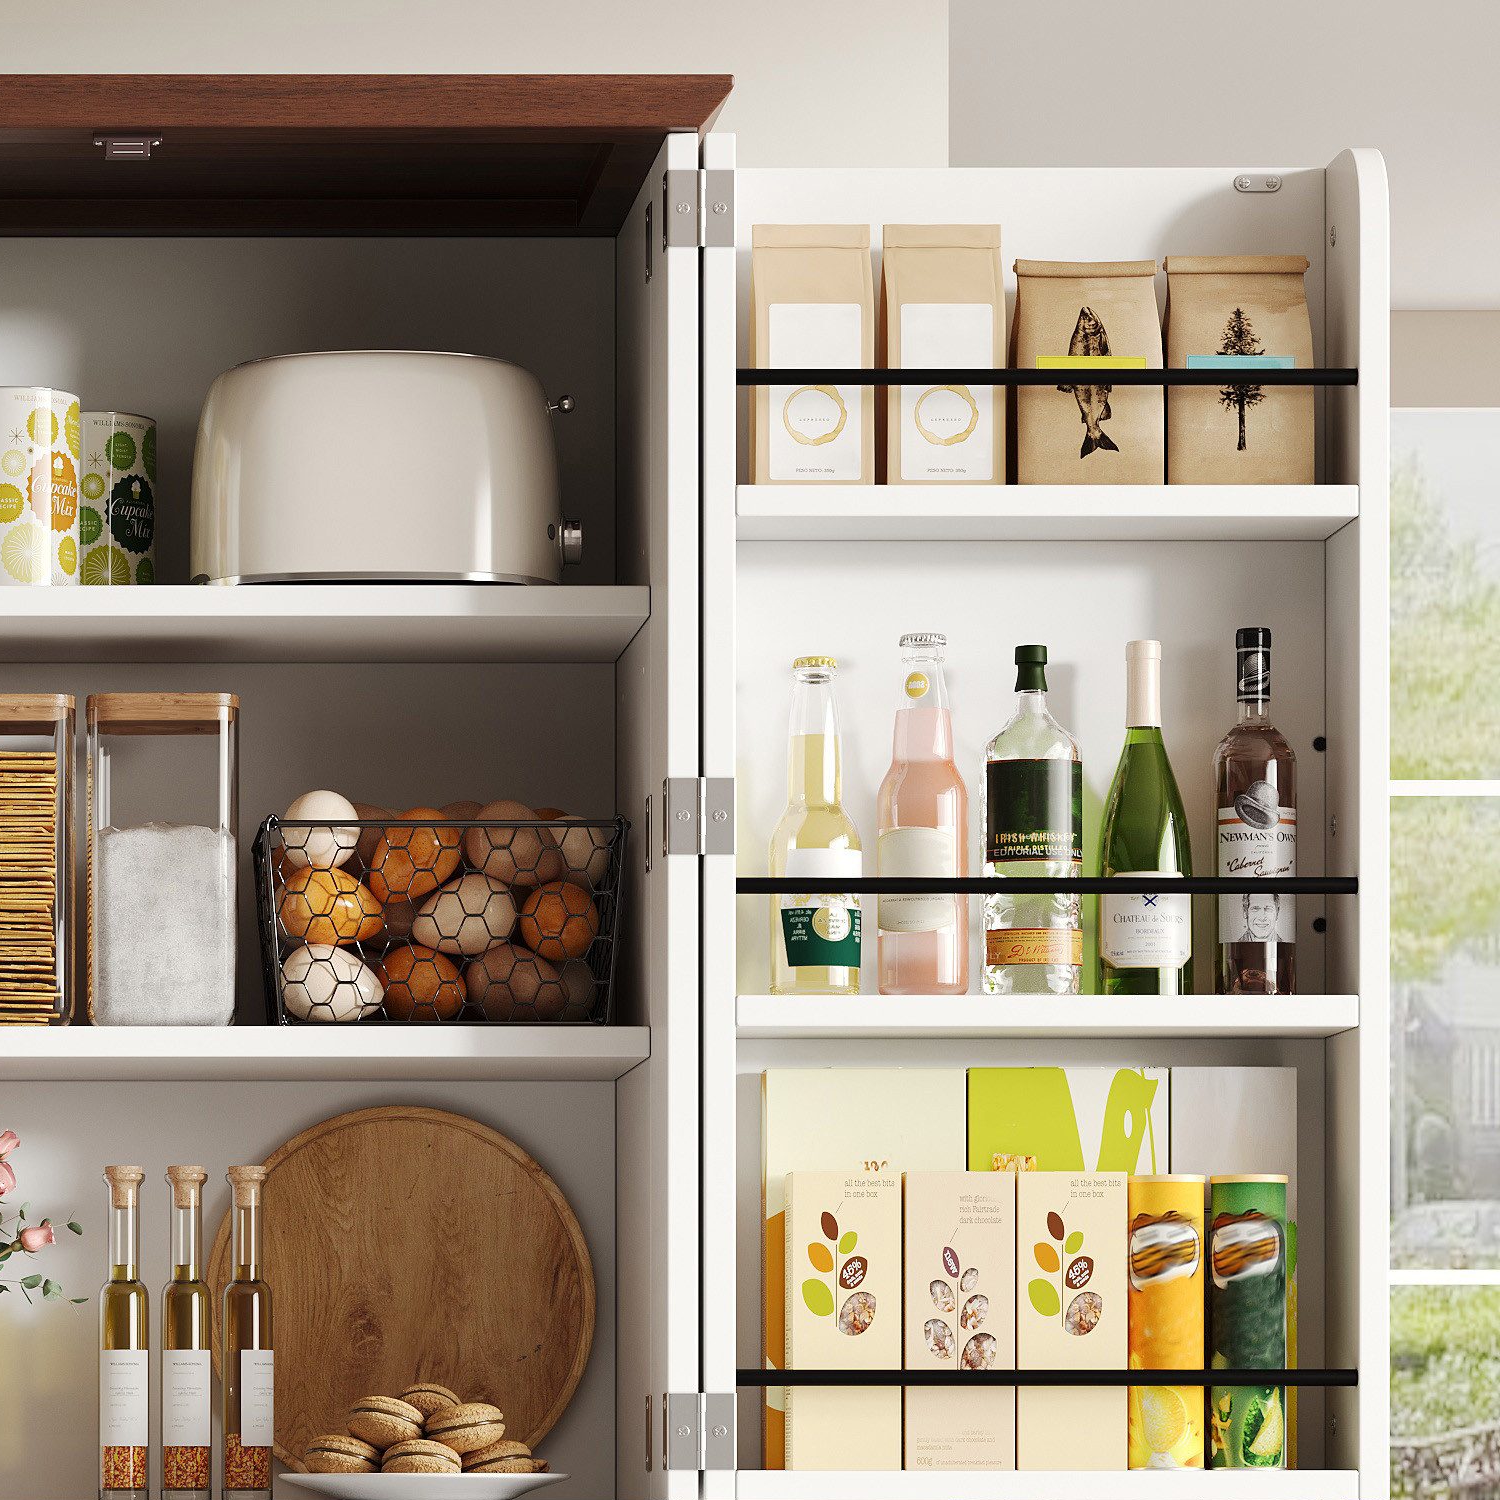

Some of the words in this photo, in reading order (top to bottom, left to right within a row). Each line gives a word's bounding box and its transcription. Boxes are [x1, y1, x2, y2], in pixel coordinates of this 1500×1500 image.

[31, 475, 77, 498] Cupcake
[50, 497, 75, 517] Mix
[110, 497, 153, 520] Cupcake
[125, 517, 151, 538] Mix
[995, 832, 1025, 844] IRISH
[1219, 832, 1274, 844] NEWMAN'S
[1276, 831, 1296, 843] OWN
[993, 848, 1044, 857] EDITORIAL
[1045, 848, 1063, 857] USE
[1112, 912, 1150, 924] CHATEAU
[844, 1179, 853, 1187] all
[854, 1179, 865, 1187] the
[866, 1179, 880, 1187] best
[882, 1179, 895, 1187] bits
[1070, 1179, 1079, 1187] all
[1080, 1179, 1092, 1187] the
[1092, 1179, 1107, 1187] best
[1108, 1179, 1122, 1187] bits
[844, 1190, 851, 1198] in
[865, 1190, 878, 1198] box
[959, 1194, 973, 1202] with
[1070, 1190, 1077, 1198] in
[1091, 1190, 1104, 1198] box
[944, 1250, 958, 1274] new
